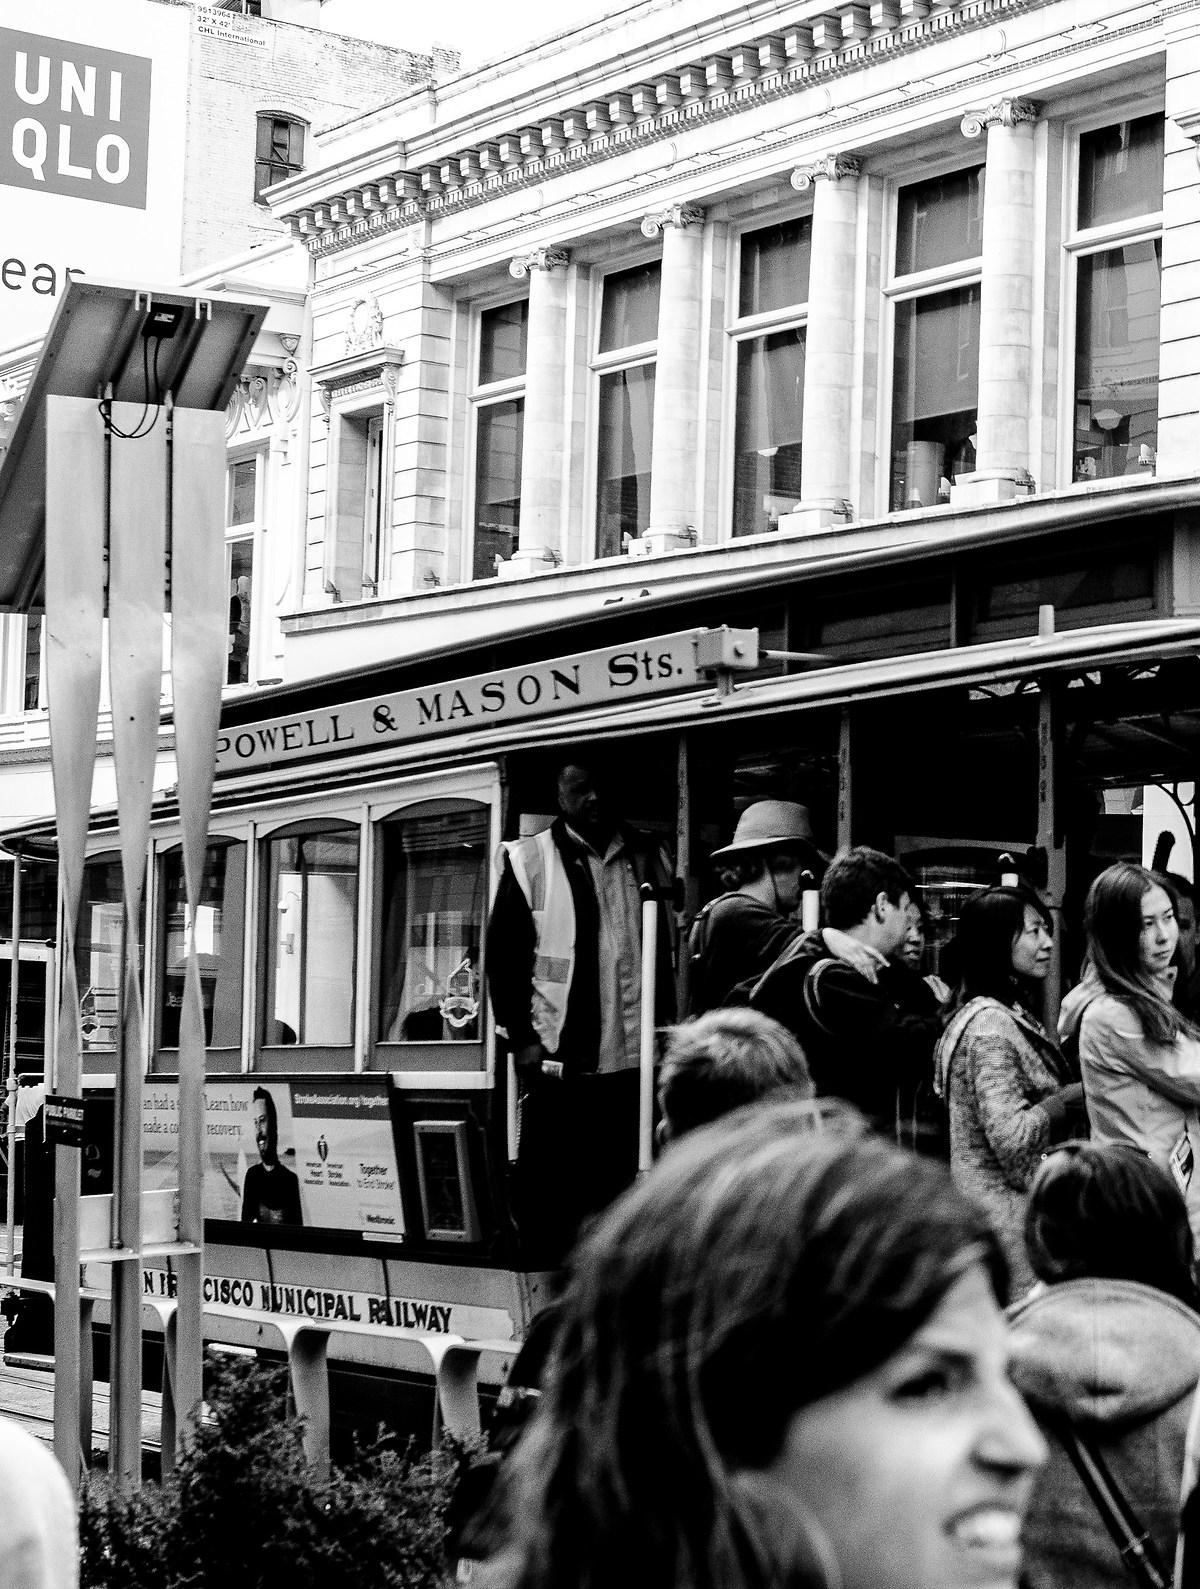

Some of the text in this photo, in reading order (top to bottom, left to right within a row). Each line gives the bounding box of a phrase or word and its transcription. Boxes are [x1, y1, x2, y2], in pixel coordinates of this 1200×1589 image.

[198, 25, 266, 46] CHL International
[15, 51, 122, 122] UNI
[12, 117, 130, 184] QLO
[216, 650, 683, 763] POWELL & MASON Sts.
[260, 1284, 361, 1322] MUNICIPAL
[367, 1297, 453, 1334] RAILWAY
